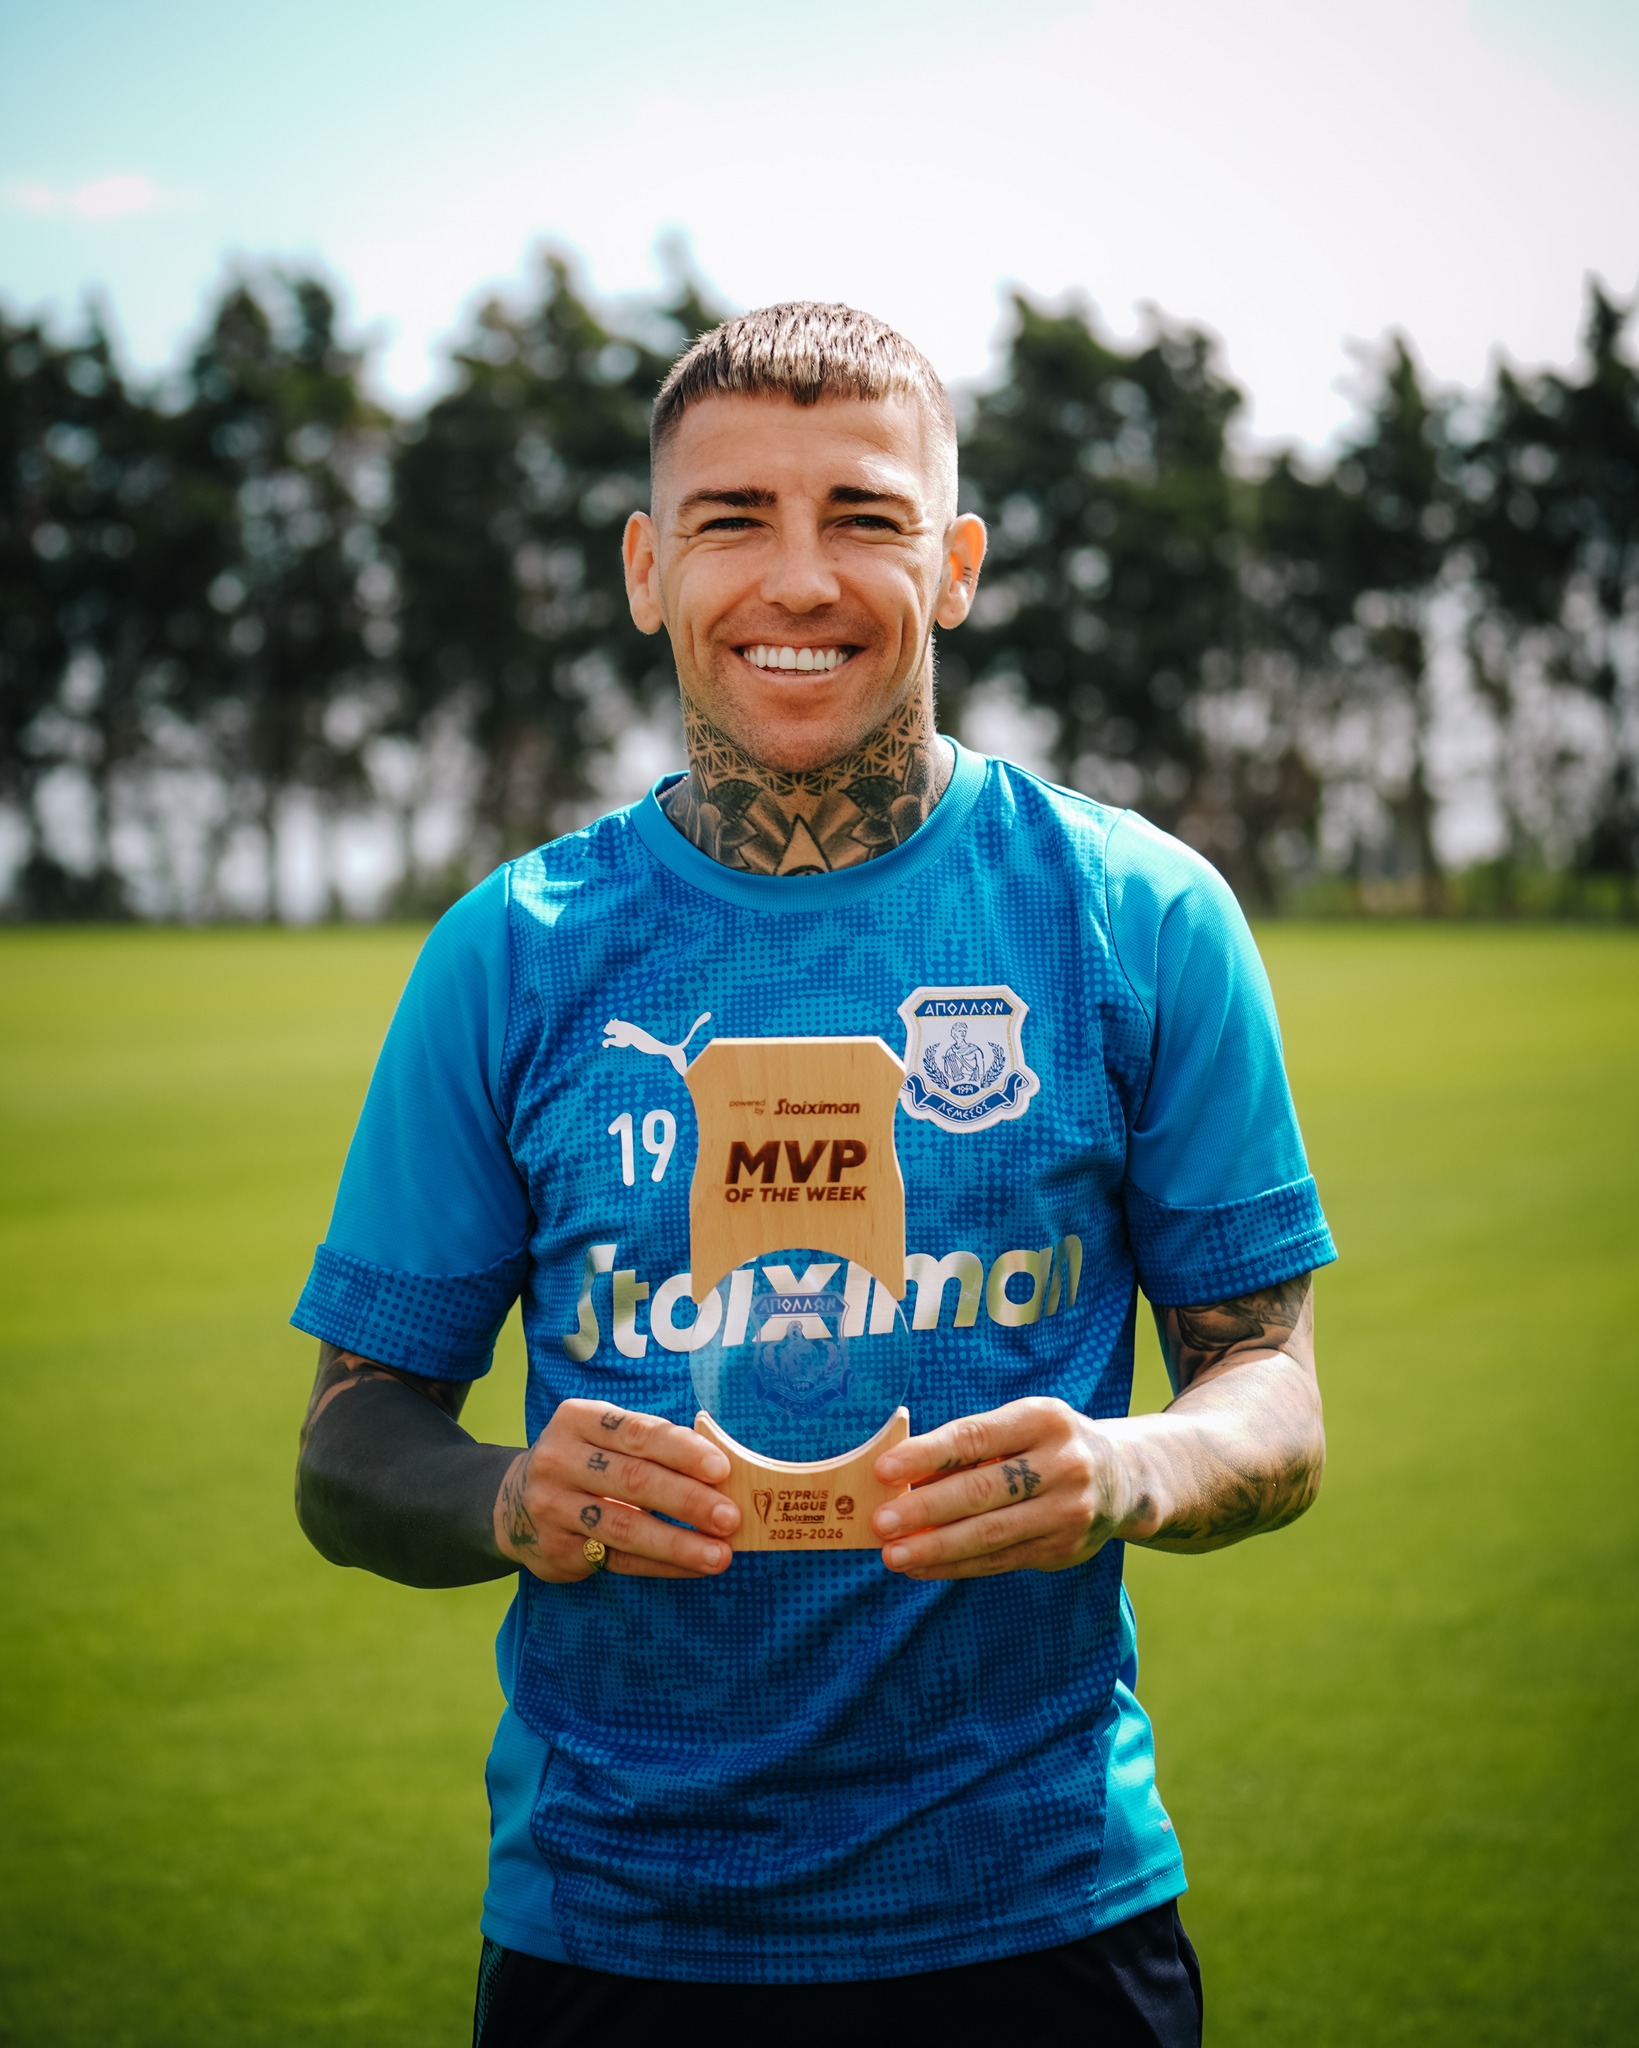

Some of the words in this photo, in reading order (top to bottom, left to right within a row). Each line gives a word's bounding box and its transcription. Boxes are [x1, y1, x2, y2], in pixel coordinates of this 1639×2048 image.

[924, 1001, 1004, 1016] ΑΠΟΛΛΩΝ
[729, 1099, 766, 1108] powered
[774, 1098, 861, 1115] Stoiximan
[754, 1108, 765, 1116] by
[607, 1109, 677, 1187] 19
[725, 1140, 867, 1184] MVP
[725, 1187, 754, 1203] OF
[760, 1186, 800, 1202] THE
[806, 1186, 867, 1201] WEEK
[759, 1298, 837, 1313] ΑΠΟΛΛΩΝ
[778, 1490, 829, 1500] CYPRUS
[776, 1501, 827, 1511] LEAGUE
[780, 1513, 825, 1522] Stoiximan
[768, 1529, 844, 1540] 2025-2026
